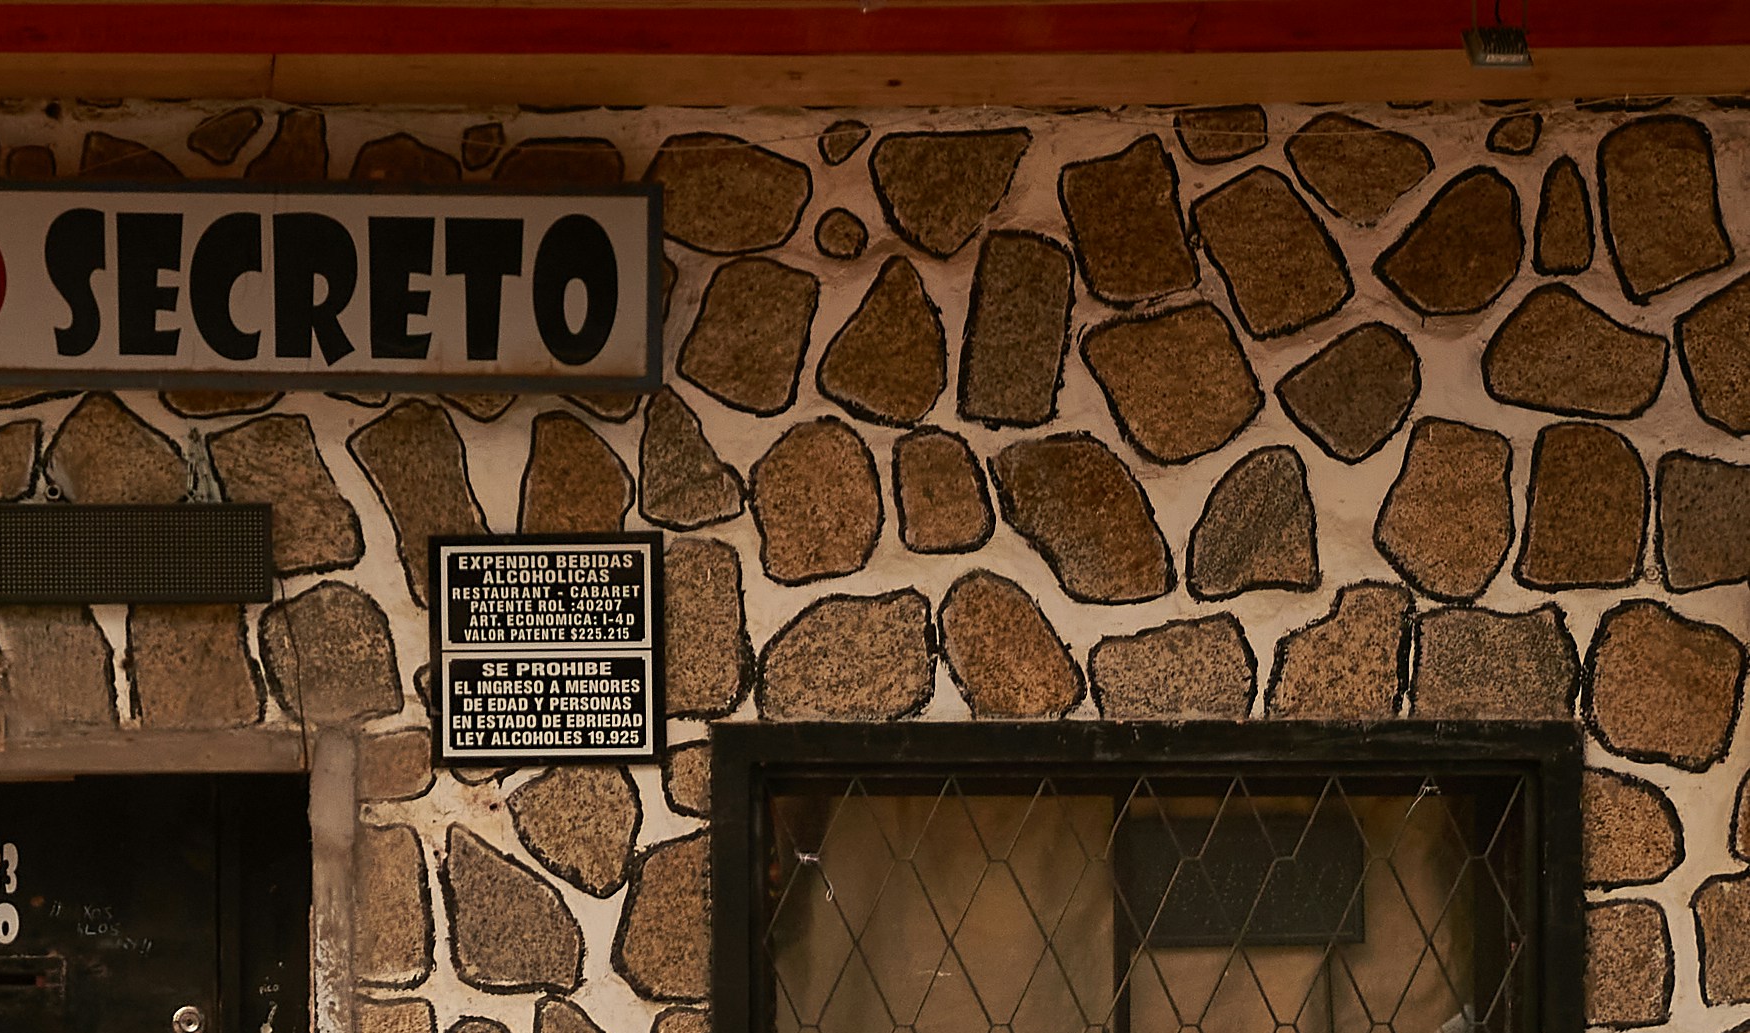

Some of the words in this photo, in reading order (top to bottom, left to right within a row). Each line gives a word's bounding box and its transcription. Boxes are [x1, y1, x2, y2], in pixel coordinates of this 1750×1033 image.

[44, 207, 619, 366] SECRETO
[458, 555, 549, 570] EXPENDIO
[555, 553, 634, 569] BEBIDAS
[482, 569, 610, 584] ALCOHOLICAS
[452, 585, 551, 600] RESTAURANT
[570, 584, 641, 599] CABARET
[470, 600, 532, 613] PATENTE
[538, 600, 566, 612] ROL
[469, 614, 501, 627] ART.
[506, 613, 598, 627] ECONOMICA:
[464, 629, 505, 642] VALOR
[510, 628, 565, 641] PATENTE
[570, 627, 630, 641] $225.215
[481, 662, 509, 677] SE
[516, 661, 612, 676] PROHIBE
[454, 681, 472, 695] EL
[477, 680, 544, 695] INGRESO
[549, 680, 560, 694] A
[565, 679, 641, 693] MENORES
[463, 698, 483, 712] DE
[487, 697, 529, 712] EDAD
[534, 697, 545, 711] Y
[550, 696, 632, 711] PERSONAS
[452, 715, 472, 729] EN
[476, 714, 537, 729] ESTADO
[542, 714, 561, 728] DE
[566, 713, 643, 728] EBRIEDAD
[456, 732, 484, 746] LEY
[491, 731, 583, 745] ALCOHOLES
[587, 730, 639, 745] 19.925
